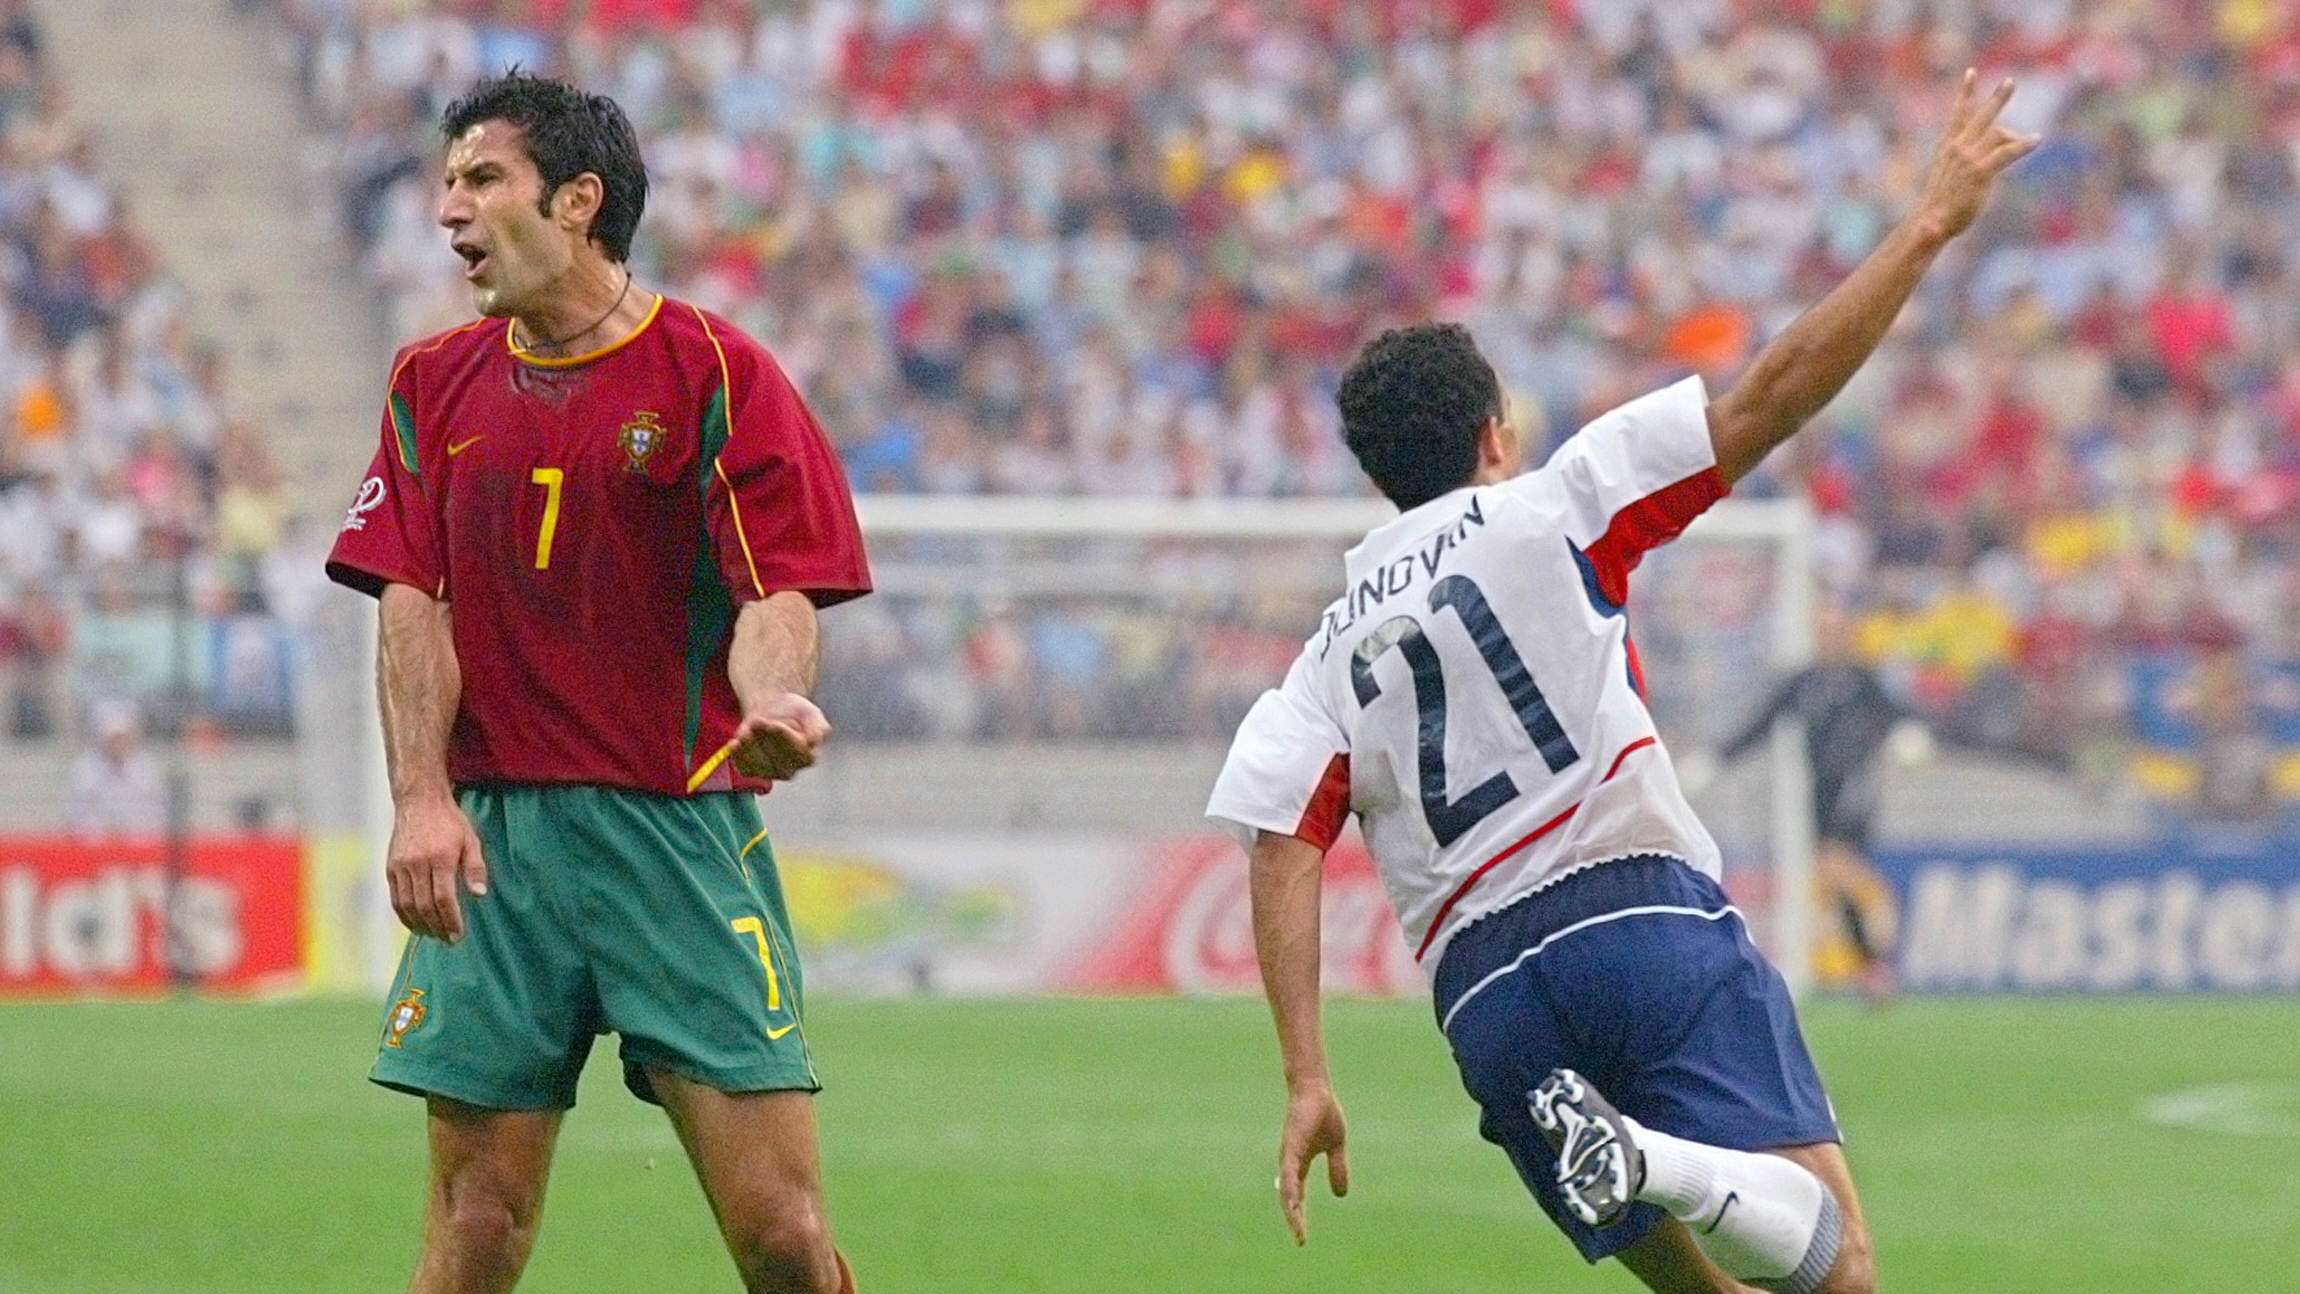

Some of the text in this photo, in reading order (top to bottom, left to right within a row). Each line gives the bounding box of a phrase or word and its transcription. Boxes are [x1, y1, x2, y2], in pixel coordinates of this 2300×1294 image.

[531, 466, 564, 570] 7
[1350, 574, 1581, 849] 21
[730, 915, 781, 1011] 7
